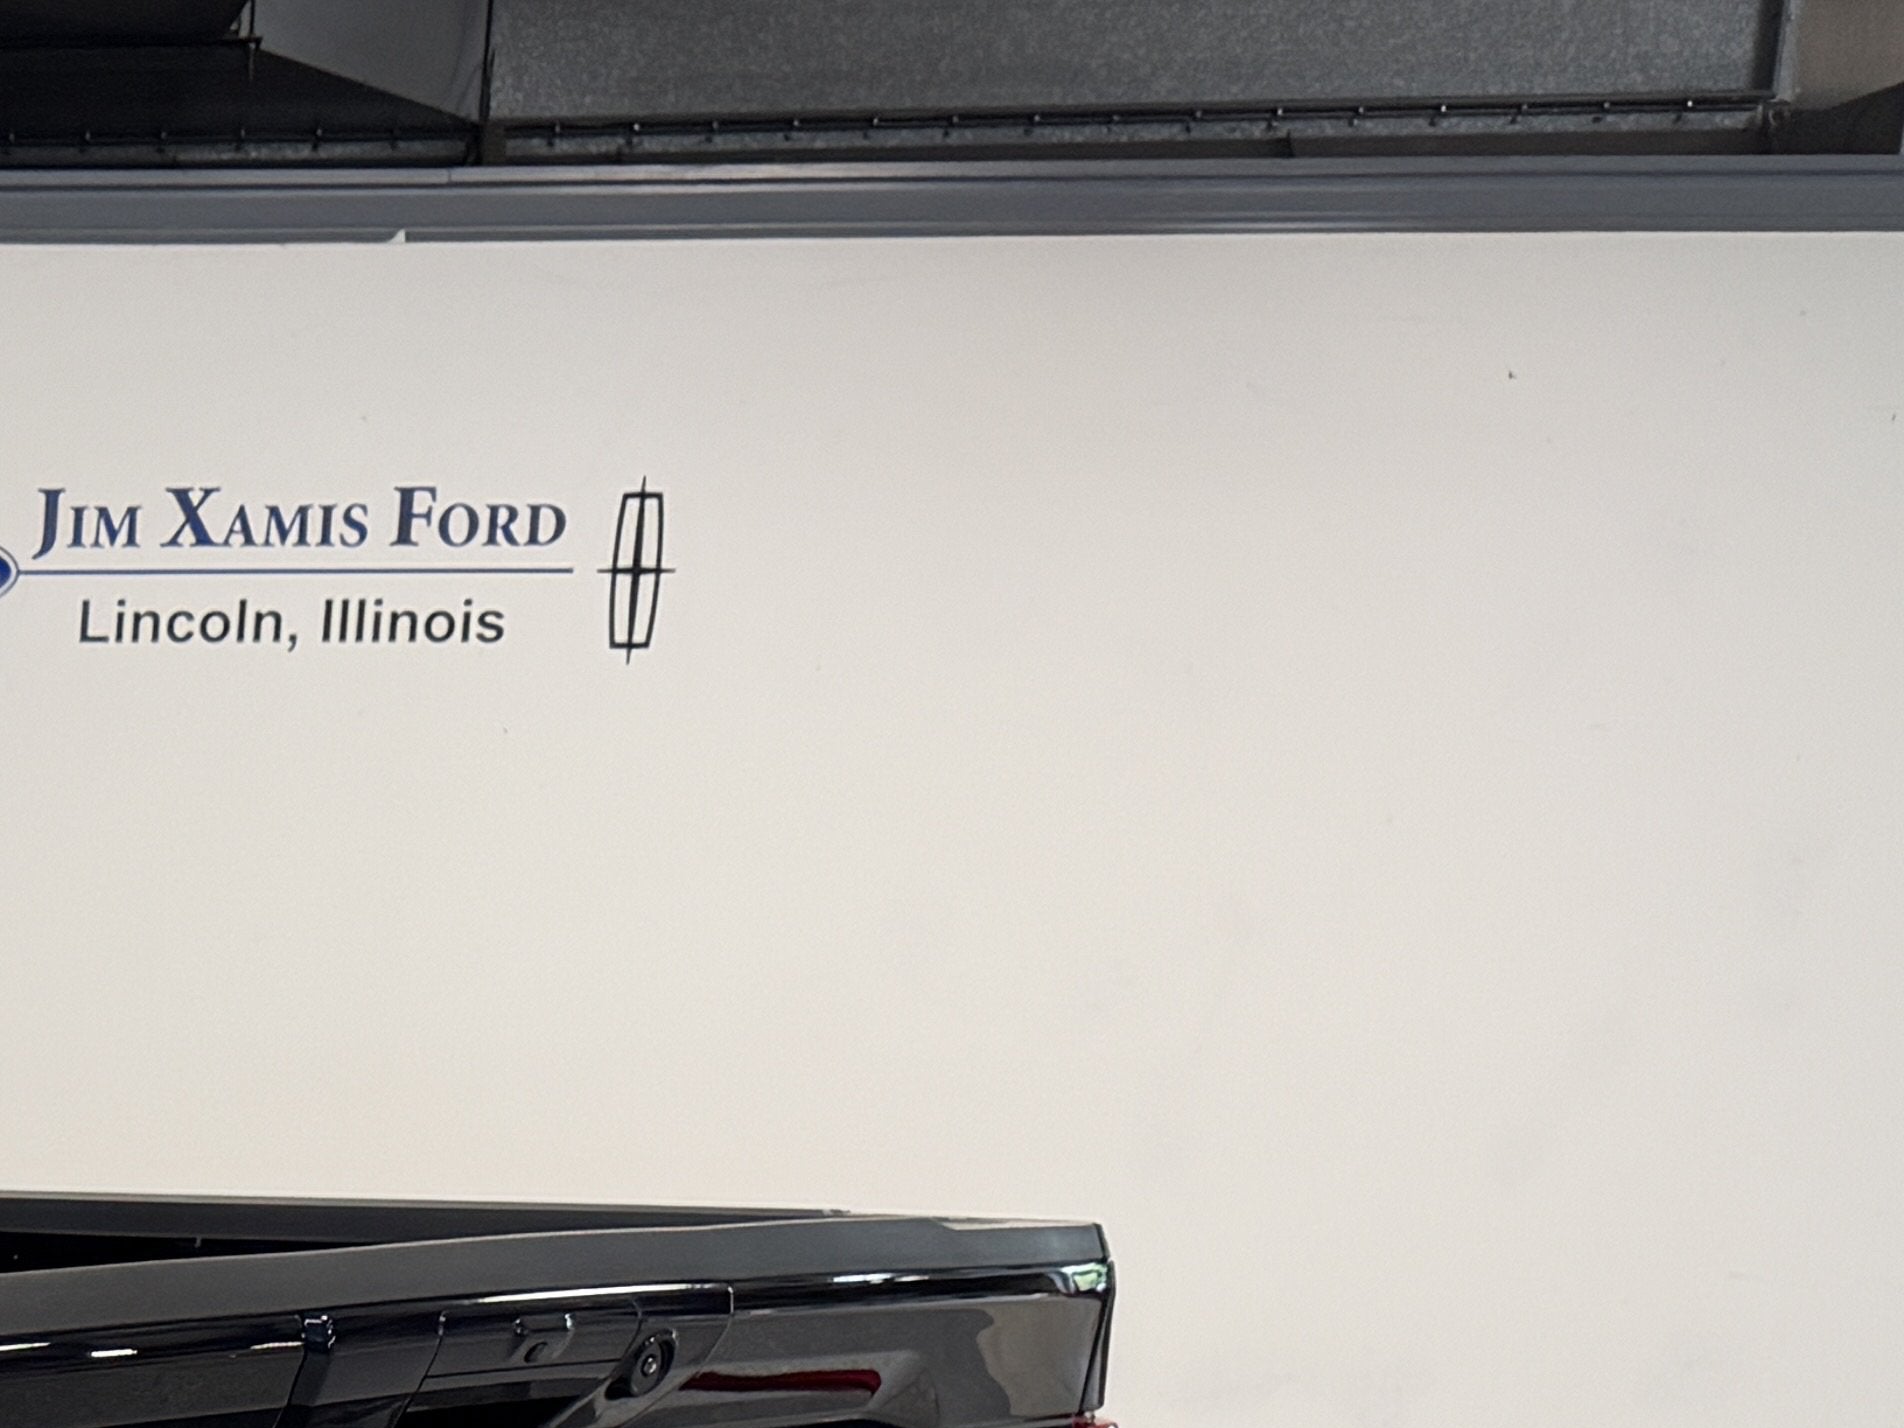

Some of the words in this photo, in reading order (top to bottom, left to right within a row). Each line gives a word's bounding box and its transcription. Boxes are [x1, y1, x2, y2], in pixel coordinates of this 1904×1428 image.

[31, 486, 142, 560] JIM
[160, 487, 370, 548] XAMIS
[390, 486, 569, 549] FORD
[78, 599, 298, 653] Lincoln,
[320, 599, 505, 644] Illinois
